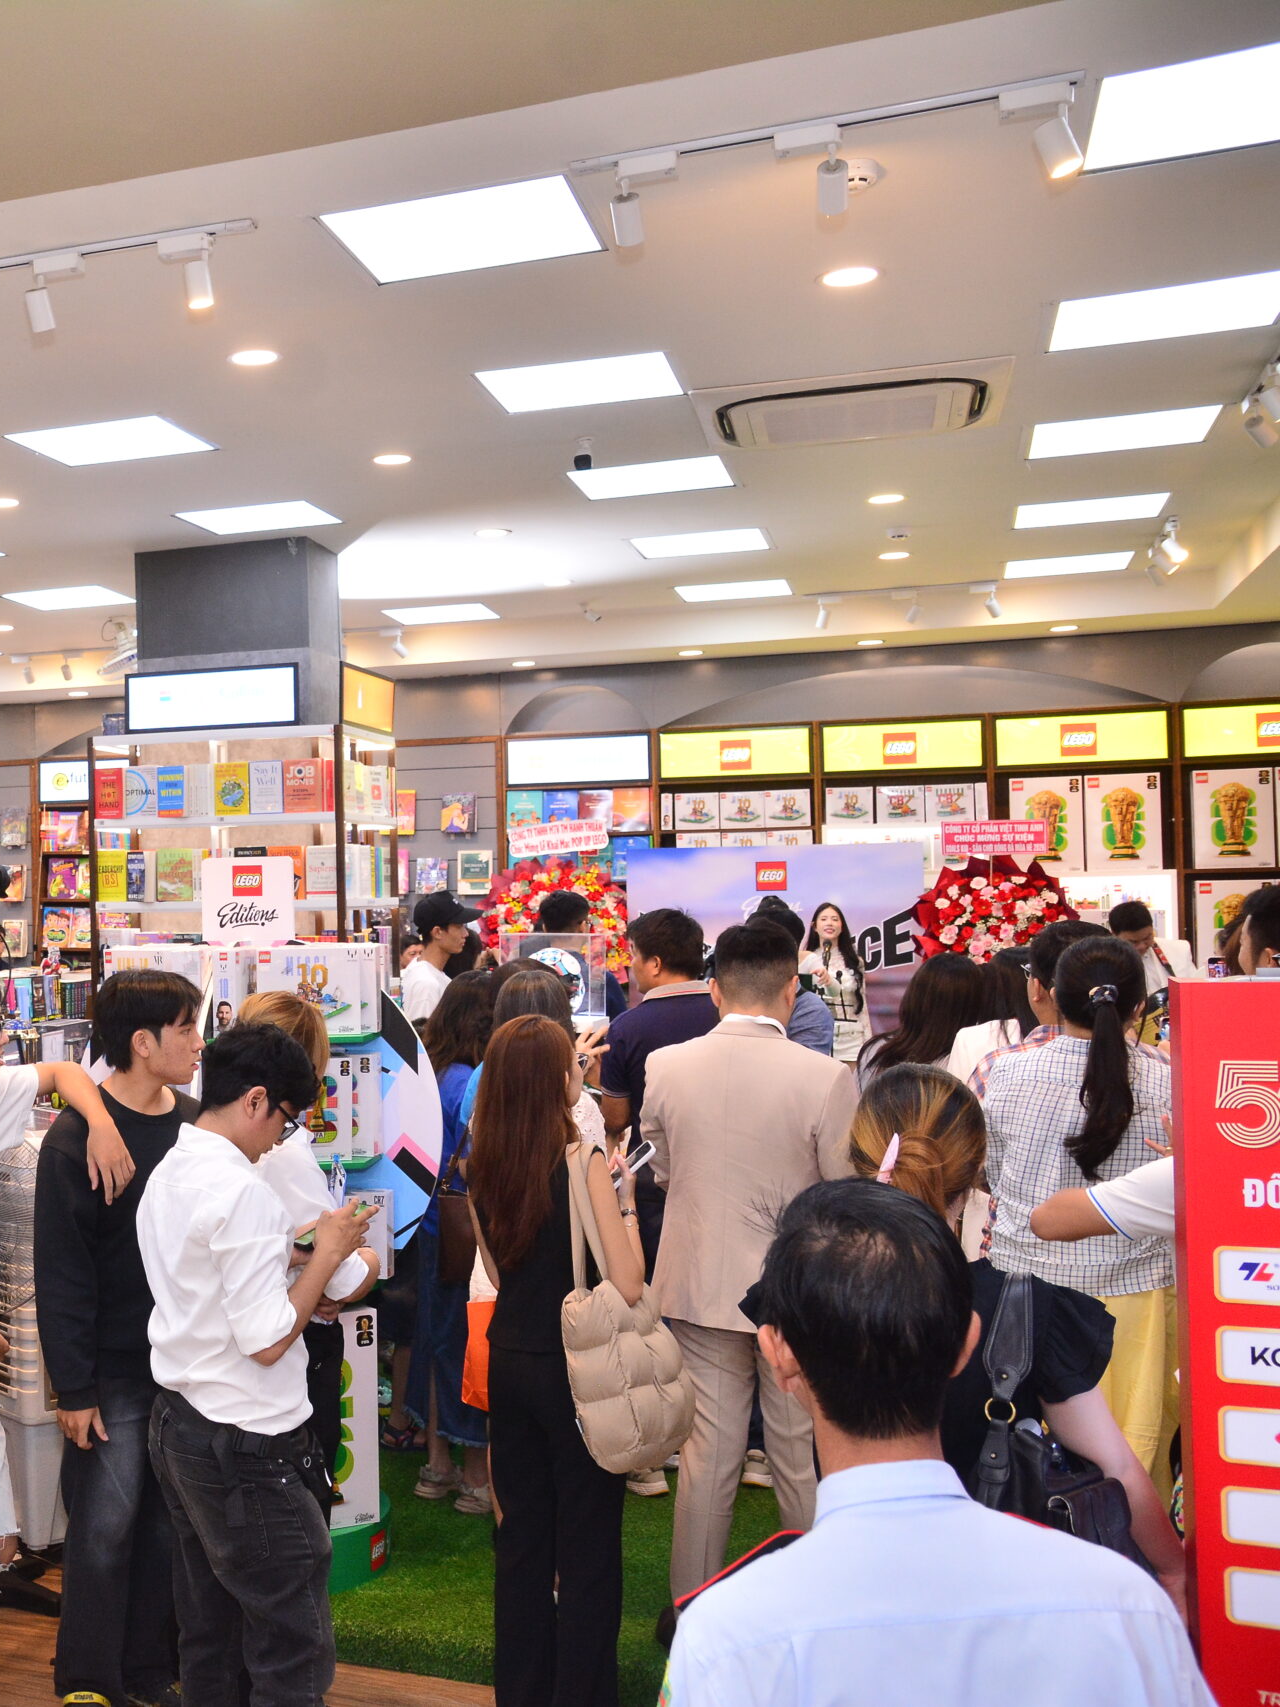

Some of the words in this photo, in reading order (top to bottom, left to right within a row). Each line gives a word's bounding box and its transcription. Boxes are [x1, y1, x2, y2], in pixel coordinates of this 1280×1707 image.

[1062, 732, 1095, 747] LEGO
[286, 765, 315, 778] JOB
[125, 789, 156, 797] OPTIMAL
[99, 801, 119, 809] HAND
[98, 864, 124, 873] EADERSHIP
[234, 875, 260, 887] LEGO
[758, 869, 784, 882] LEGO
[217, 902, 279, 928] Editions
[297, 963, 329, 989] 10
